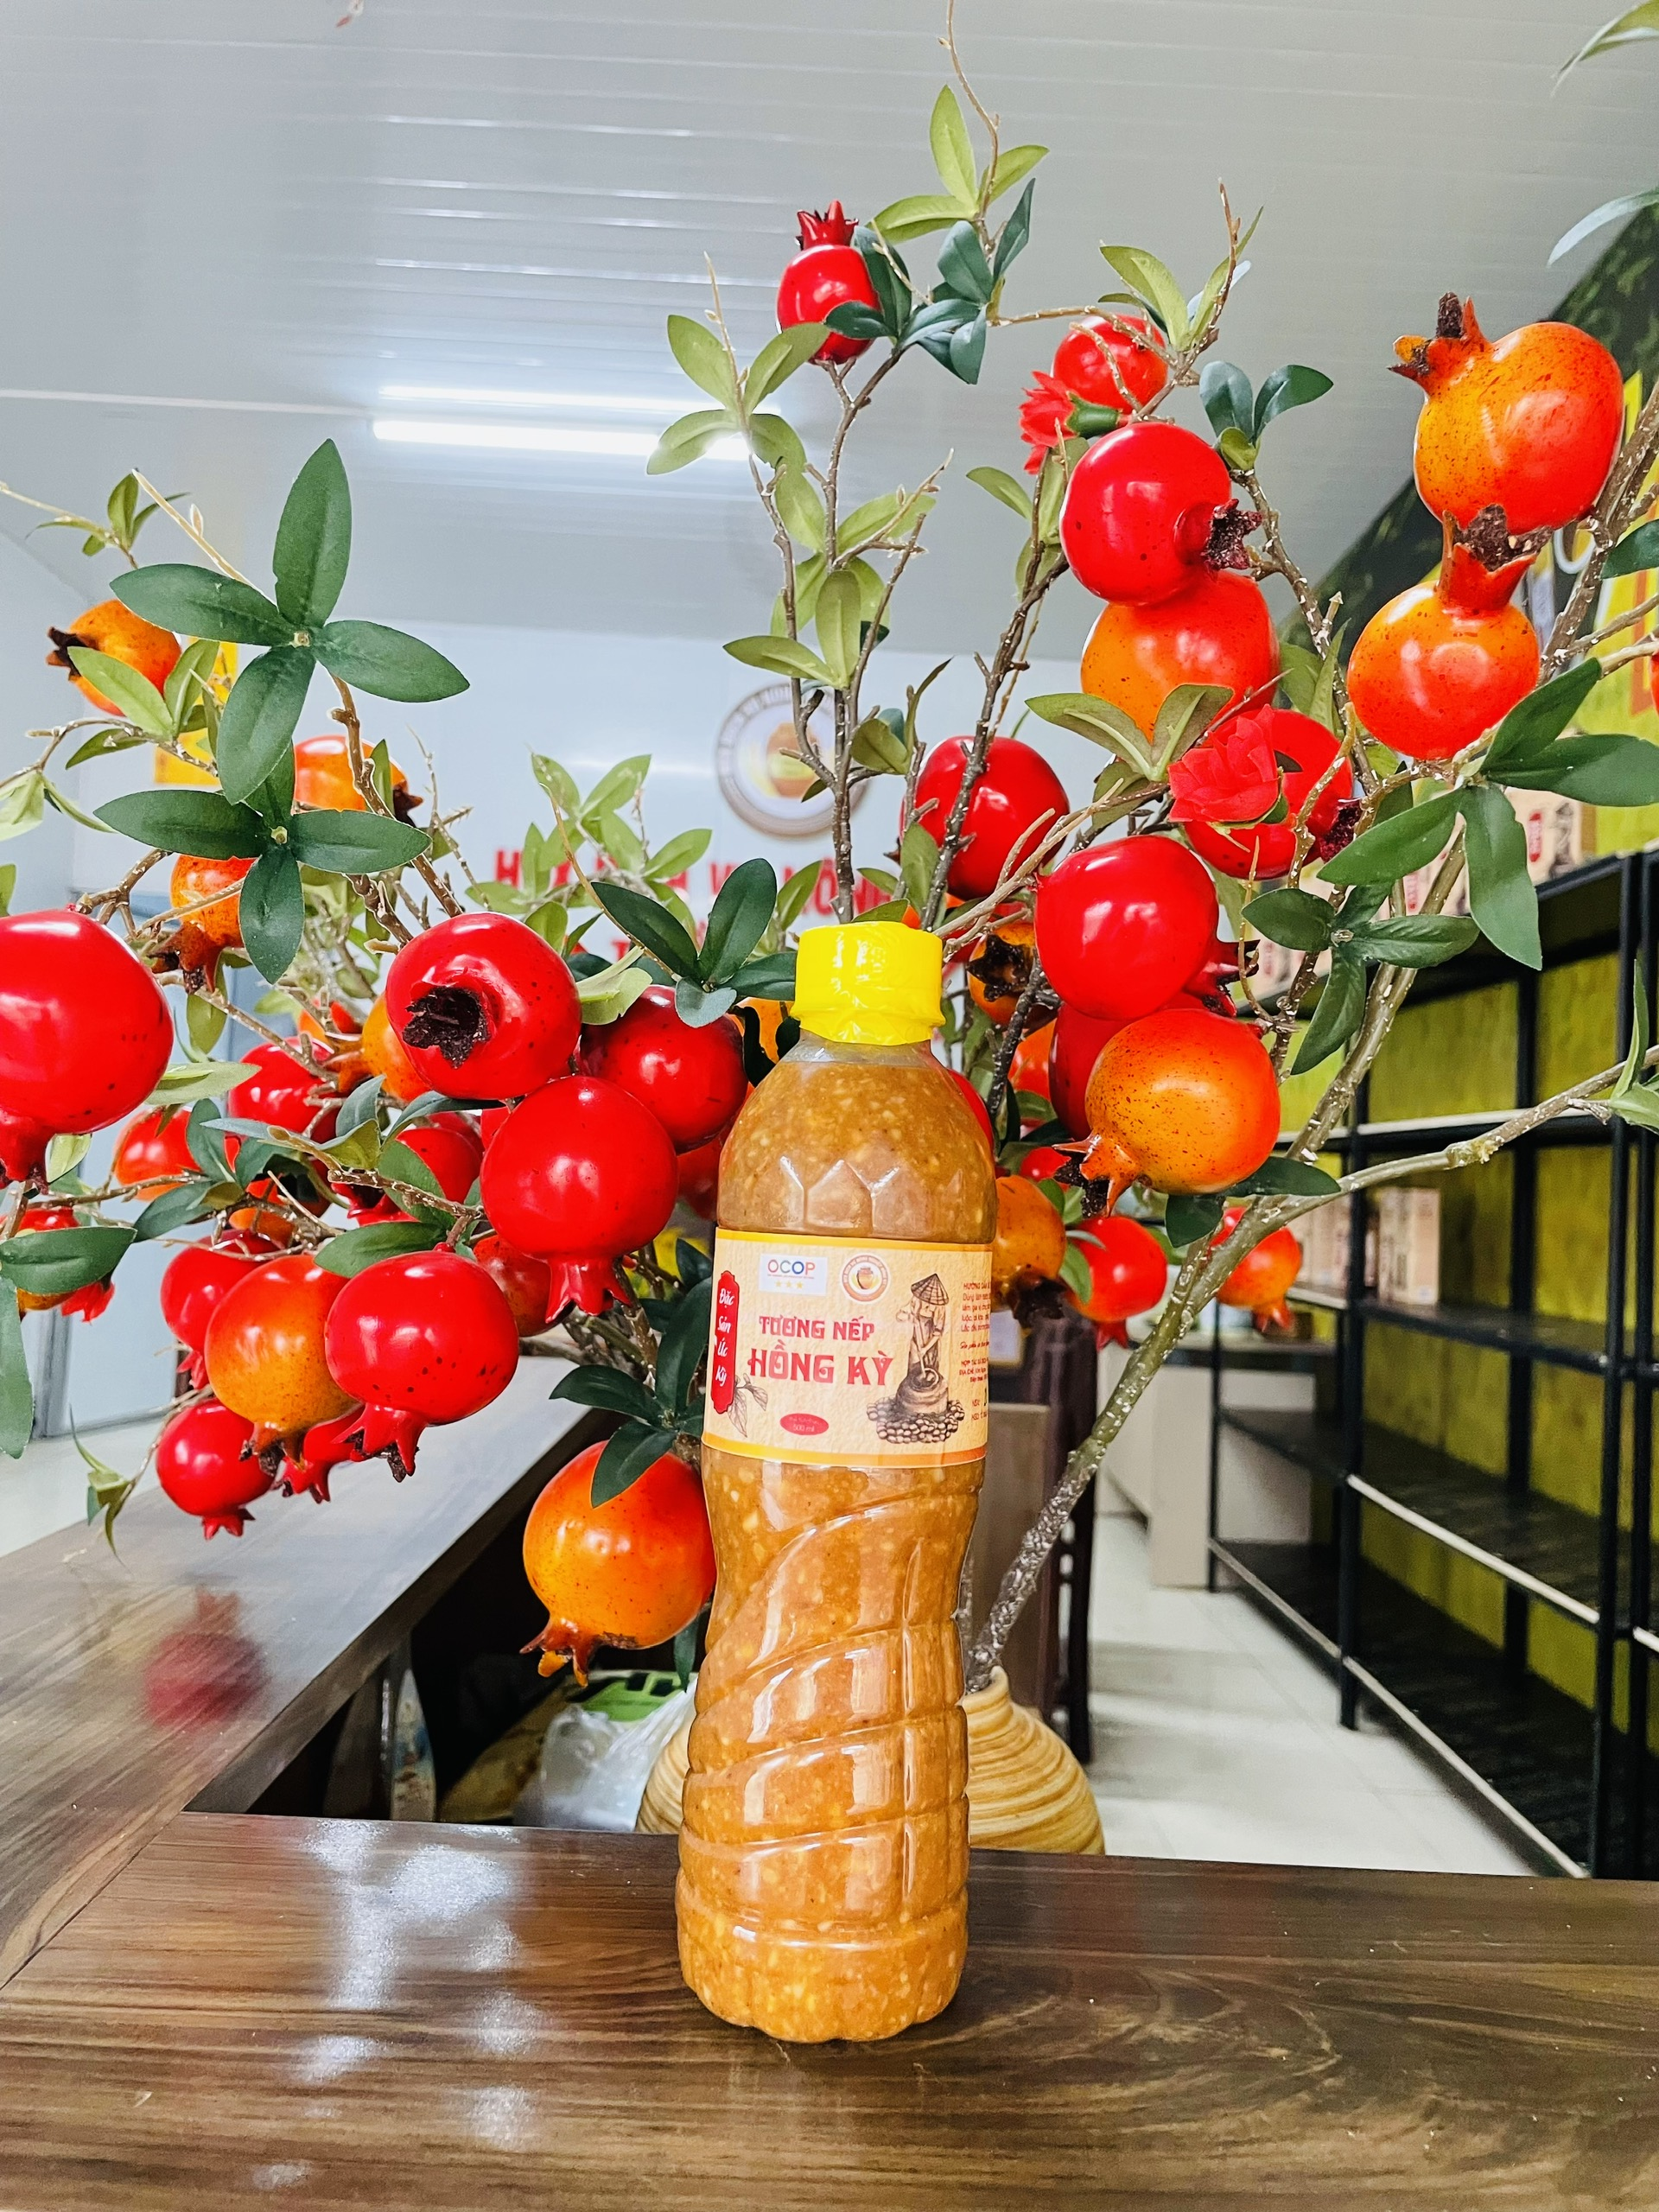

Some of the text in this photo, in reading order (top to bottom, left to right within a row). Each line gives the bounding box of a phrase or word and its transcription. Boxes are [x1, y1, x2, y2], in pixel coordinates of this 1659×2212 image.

[767, 1259, 816, 1275] OCOP
[719, 1288, 734, 1308] Đặc
[759, 1314, 875, 1341] TƯƠNG NẾP
[747, 1339, 893, 1386] HỒNG KỲ
